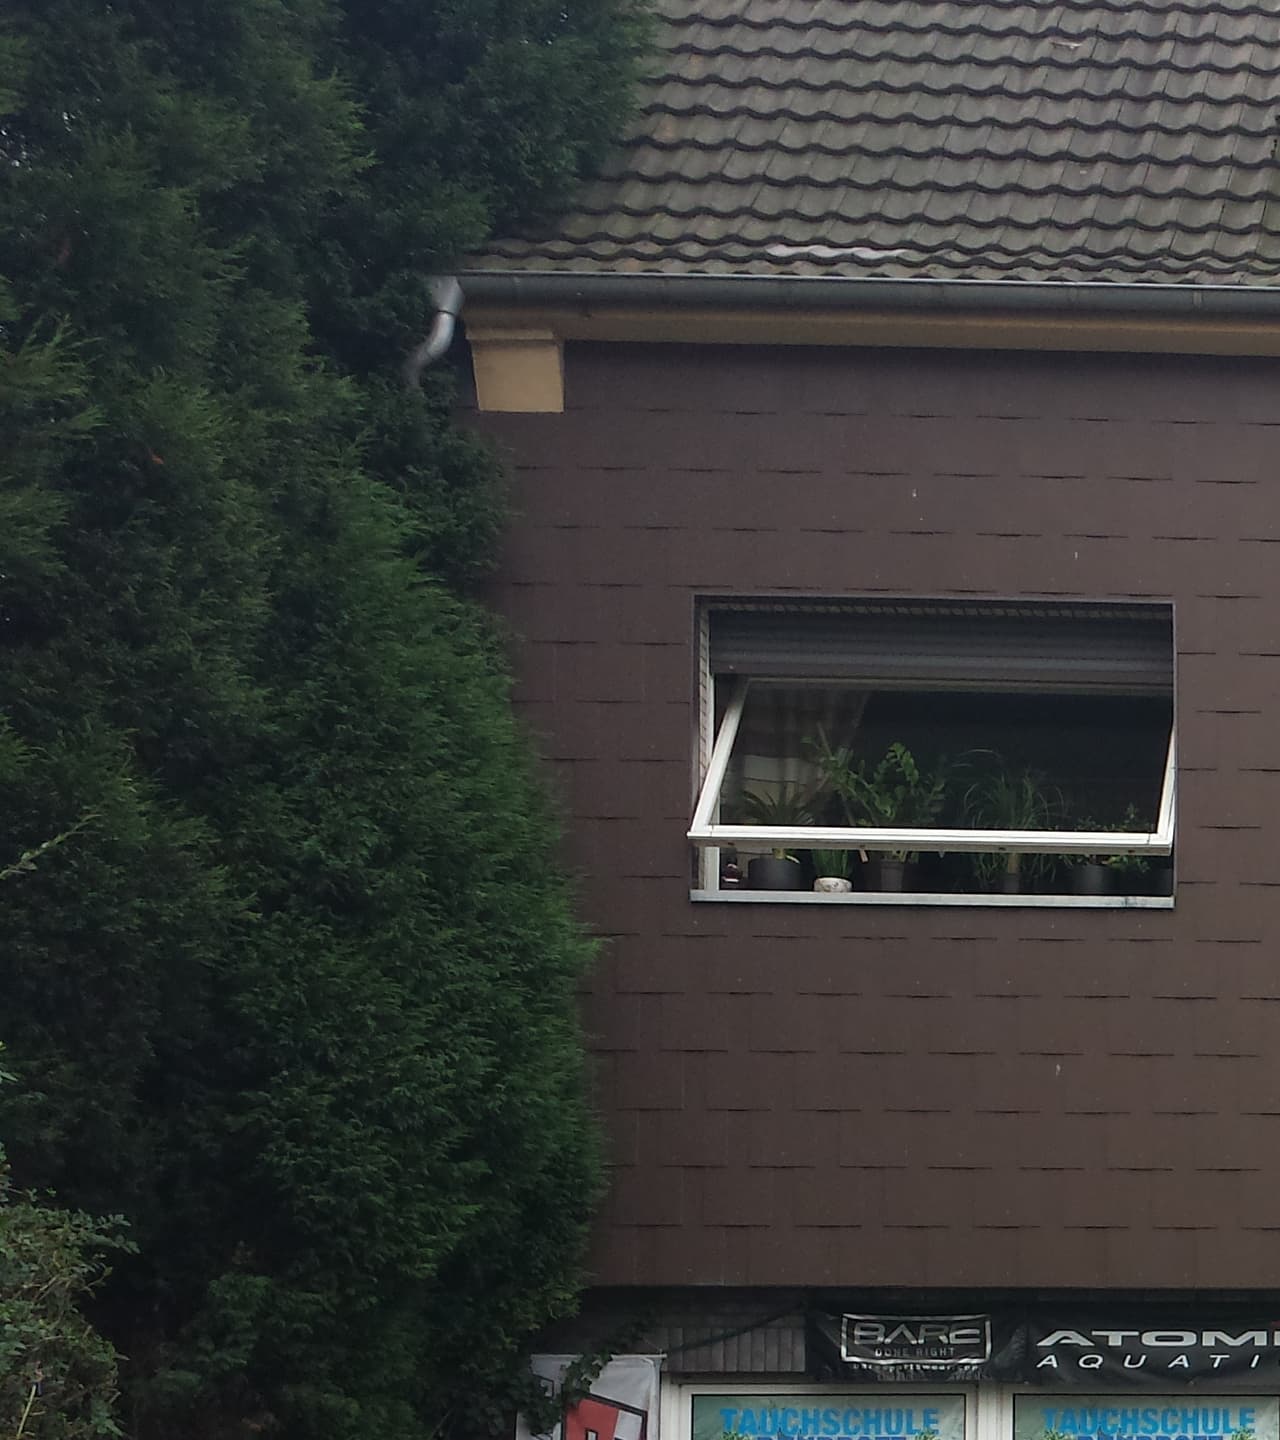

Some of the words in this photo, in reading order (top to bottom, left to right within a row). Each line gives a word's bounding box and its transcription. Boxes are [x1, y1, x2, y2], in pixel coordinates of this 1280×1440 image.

[854, 1322, 981, 1344] BARE
[720, 1408, 940, 1435] TAUCHSCHULE
[1042, 1407, 1255, 1435] TAUCHSCHULE
